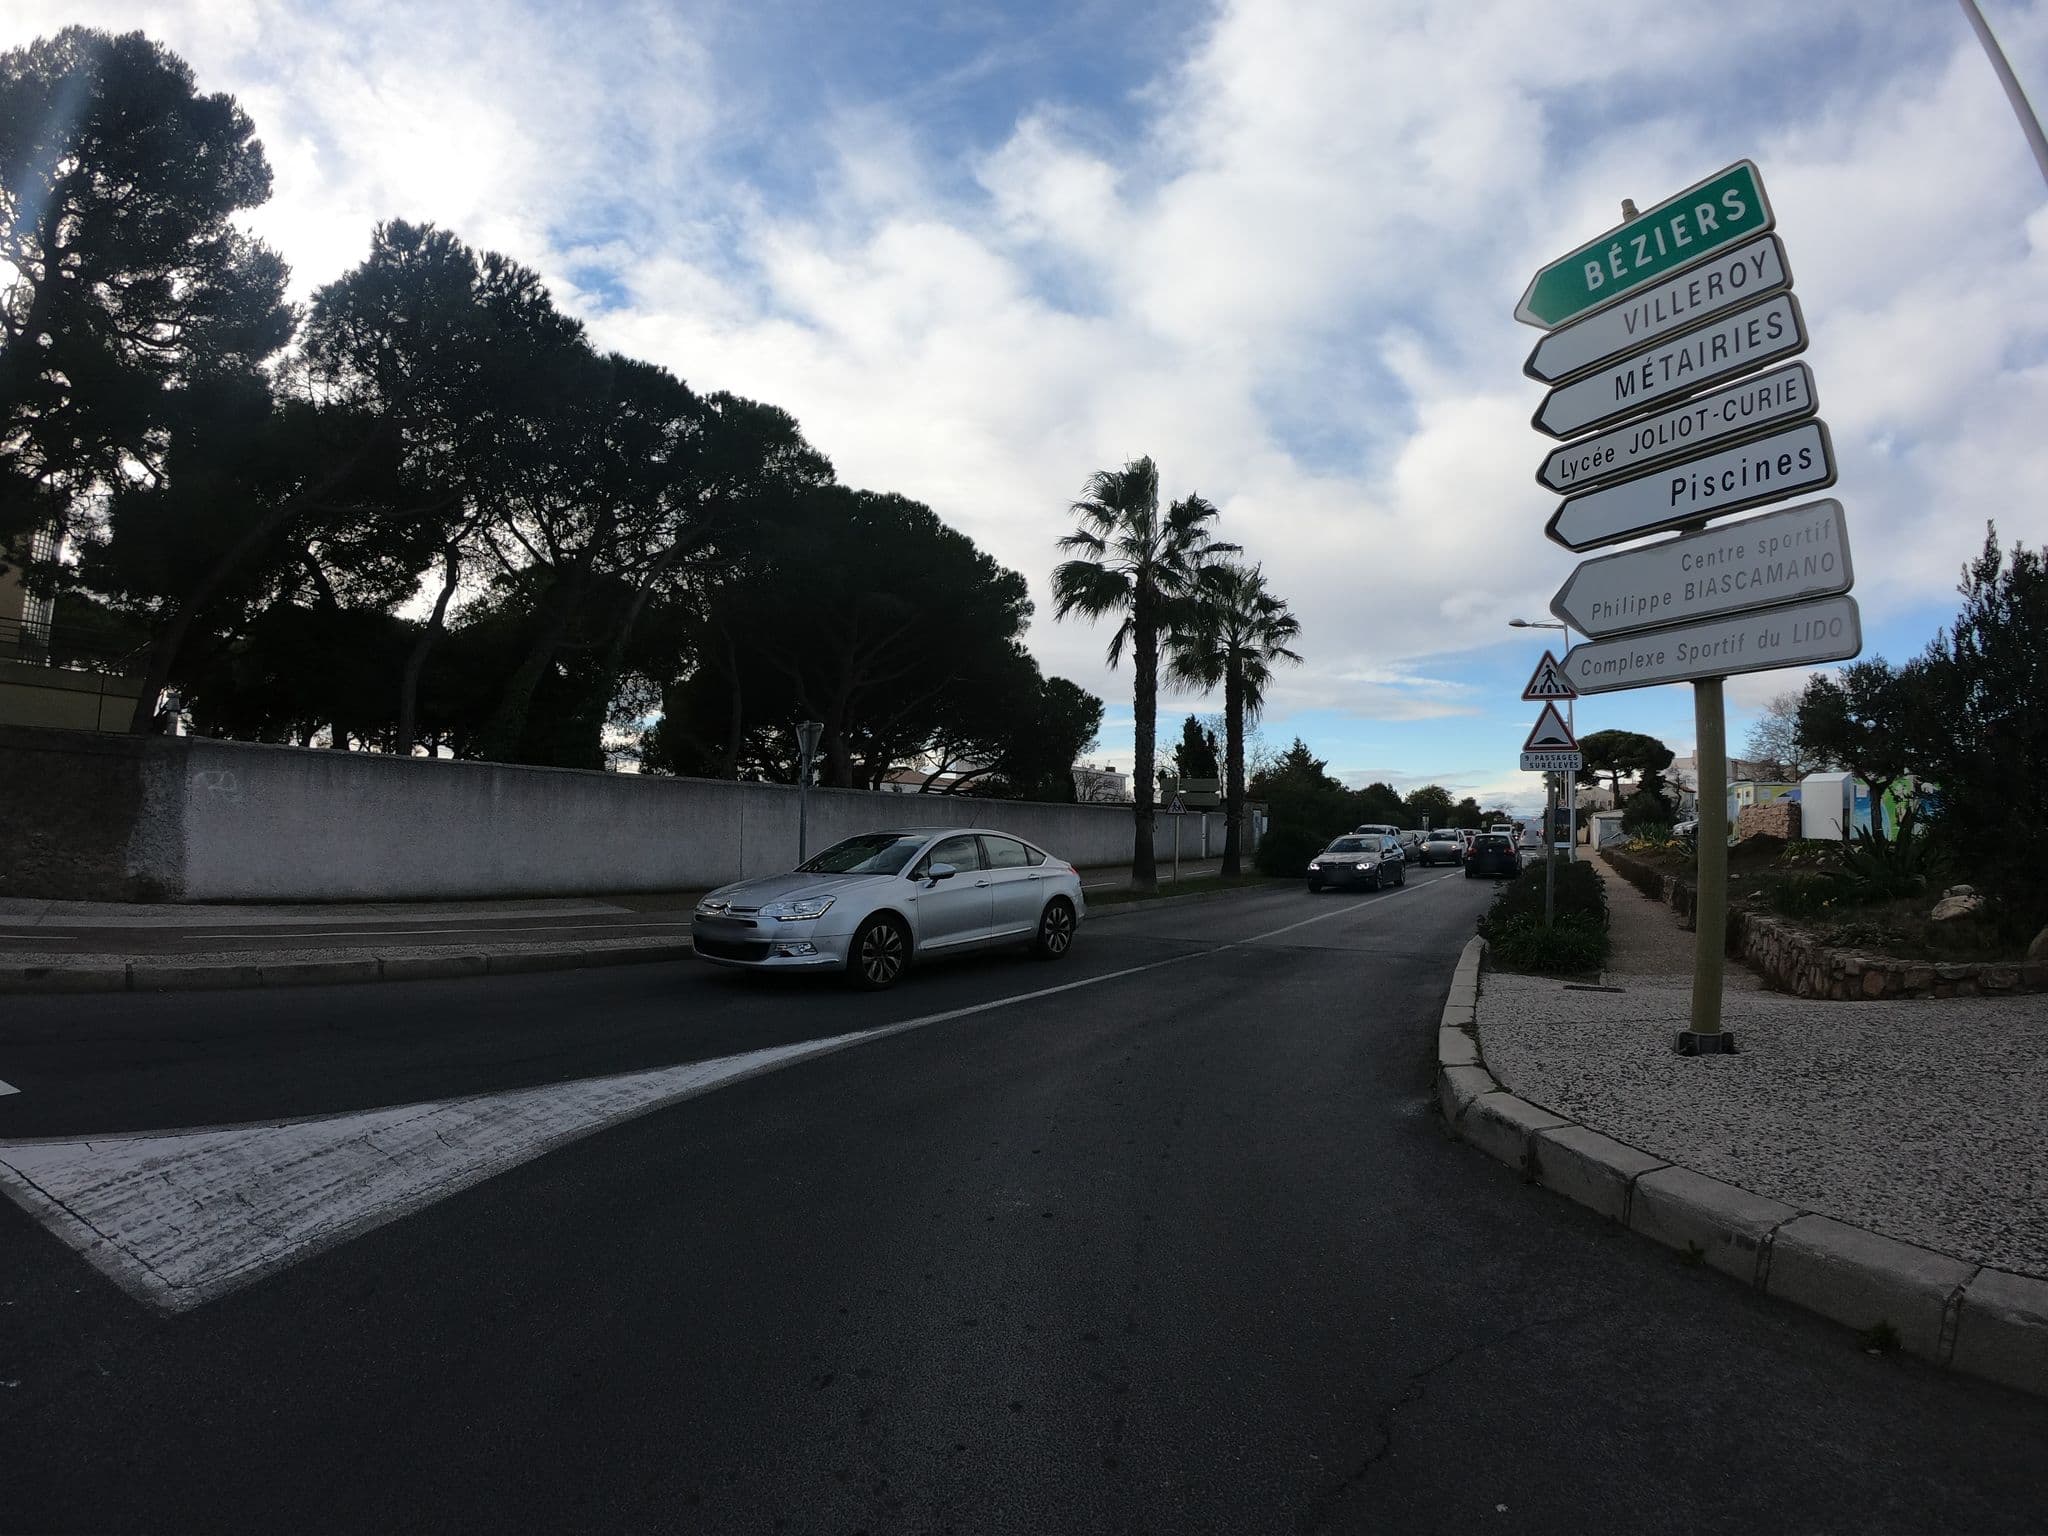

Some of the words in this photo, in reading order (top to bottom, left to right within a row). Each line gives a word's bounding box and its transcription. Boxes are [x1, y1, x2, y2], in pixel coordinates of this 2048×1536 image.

[1584, 189, 1746, 291] BÉZIERS
[1624, 251, 1767, 335] VILLEROY
[1615, 311, 1782, 400] MÉTAIRIES
[1561, 446, 1615, 480] Lycée
[1629, 378, 1797, 455] JOLIOT-CURIE
[1671, 447, 1811, 507] Piscines
[1681, 543, 1745, 571] Centre
[1758, 520, 1832, 555] sportif
[1592, 592, 1671, 620] Philippe
[1685, 552, 1834, 601] BIASCAMANO
[1581, 649, 1665, 677] Complexe
[1677, 635, 1745, 665] Sportif
[1758, 626, 1780, 648] du
[1792, 618, 1841, 644] LIDO
